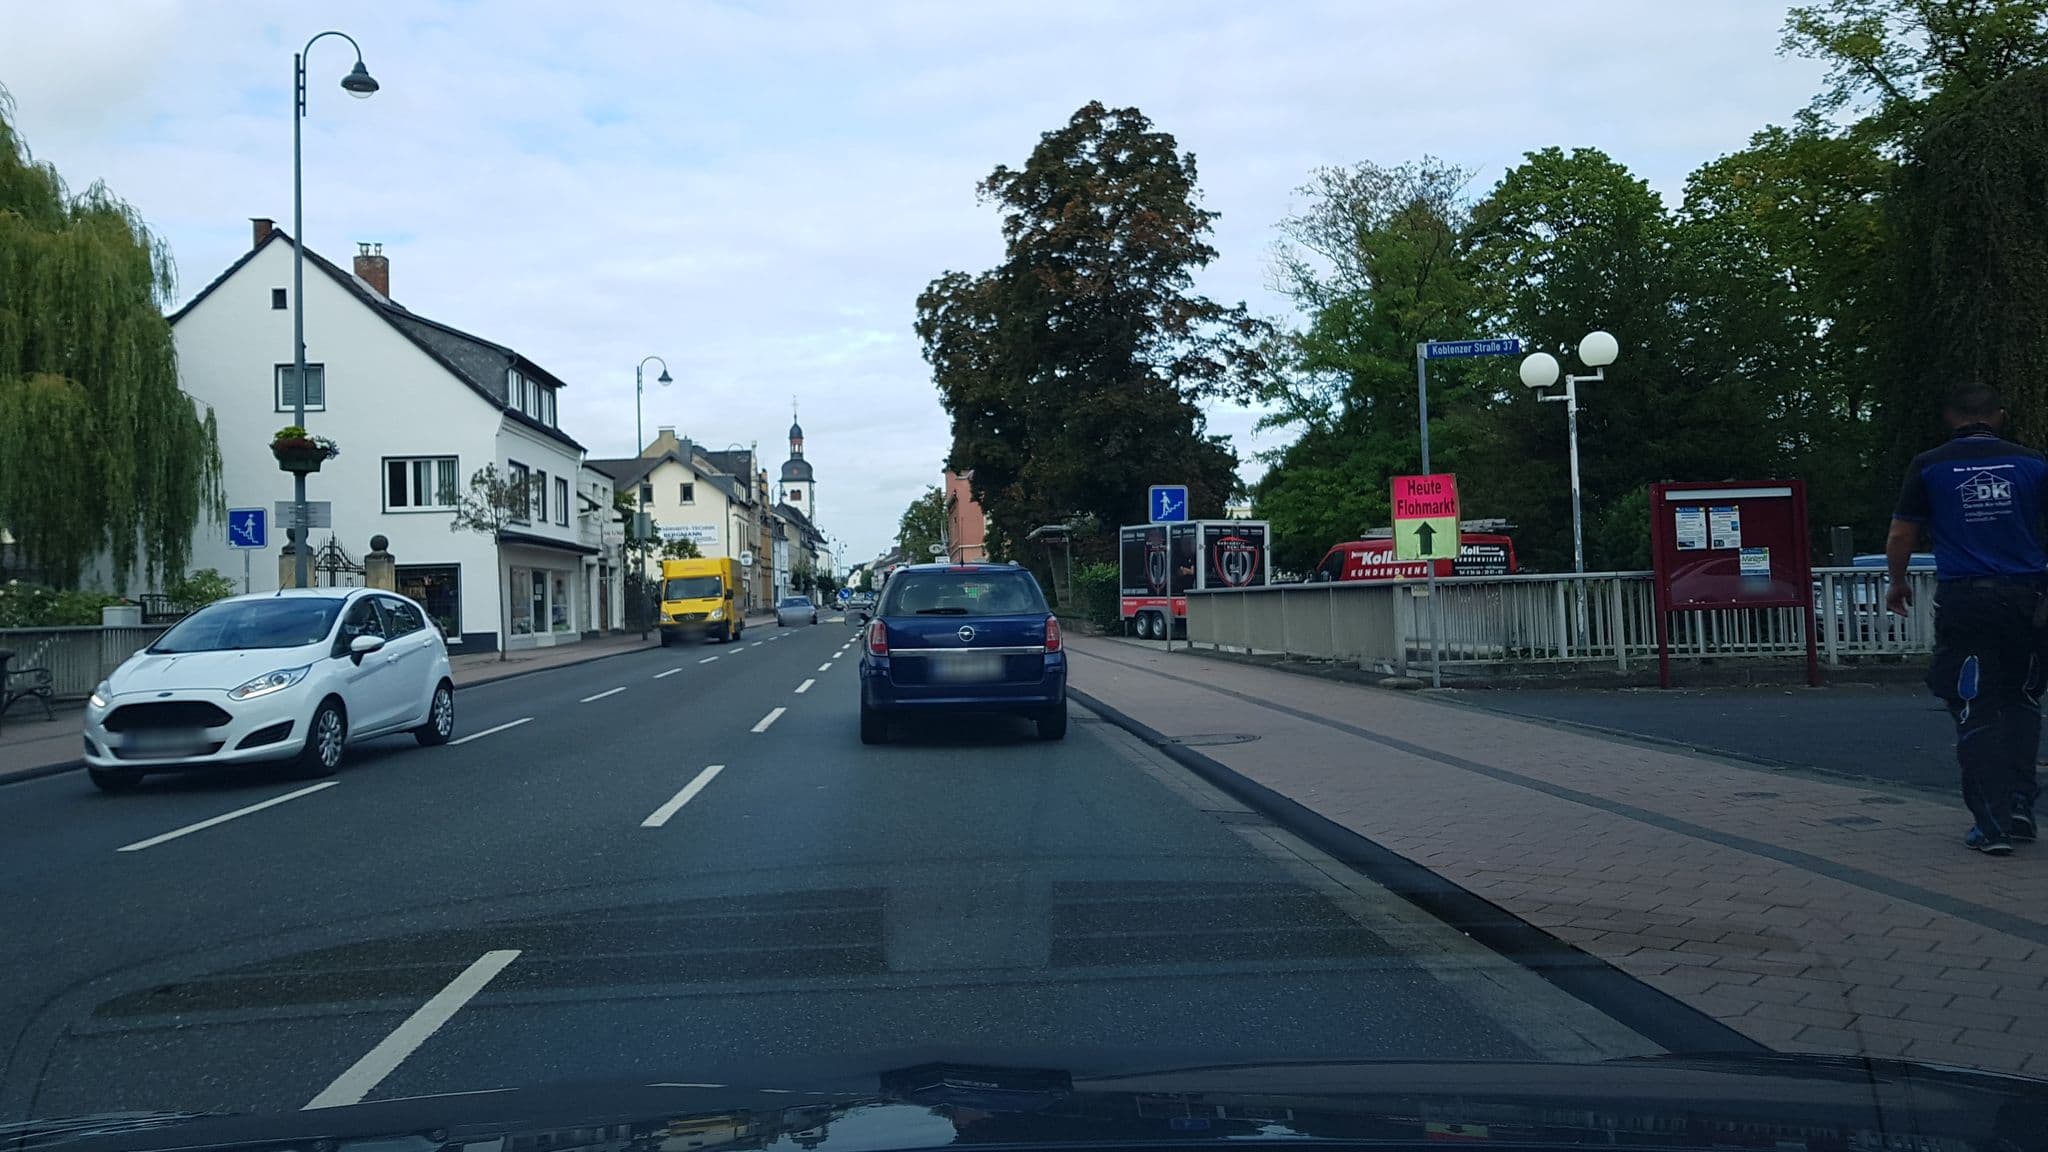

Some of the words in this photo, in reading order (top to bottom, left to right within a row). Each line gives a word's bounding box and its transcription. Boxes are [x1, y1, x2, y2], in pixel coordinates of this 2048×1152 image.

[1432, 344, 1472, 355] Koblenzer
[1474, 342, 1501, 353] Straße
[1503, 341, 1513, 351] 37
[1977, 483, 2010, 499] DK
[1397, 497, 1455, 516] Flohmarkt
[1361, 550, 1393, 566] Koll
[1460, 545, 1480, 556] Koll
[1350, 565, 1428, 577] KUNDENDIENS
